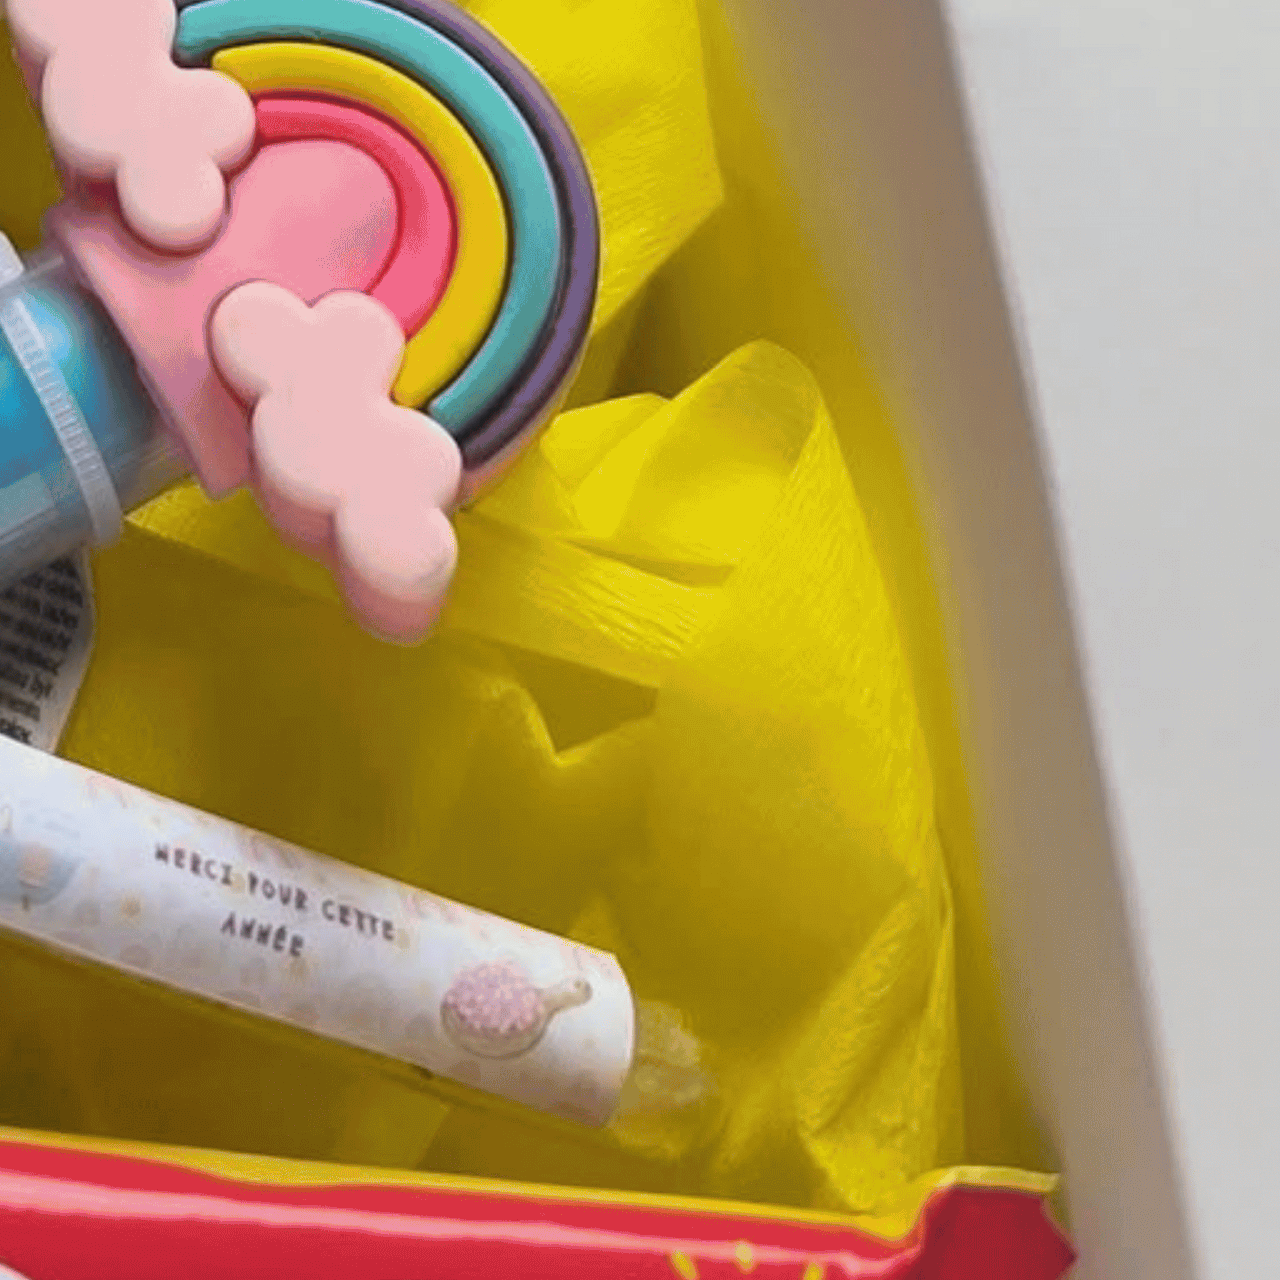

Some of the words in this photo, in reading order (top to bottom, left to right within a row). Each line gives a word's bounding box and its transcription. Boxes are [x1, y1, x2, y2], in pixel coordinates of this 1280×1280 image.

[154, 841, 233, 887] MERCI
[247, 871, 310, 912] POUR
[321, 898, 396, 942] CETTE
